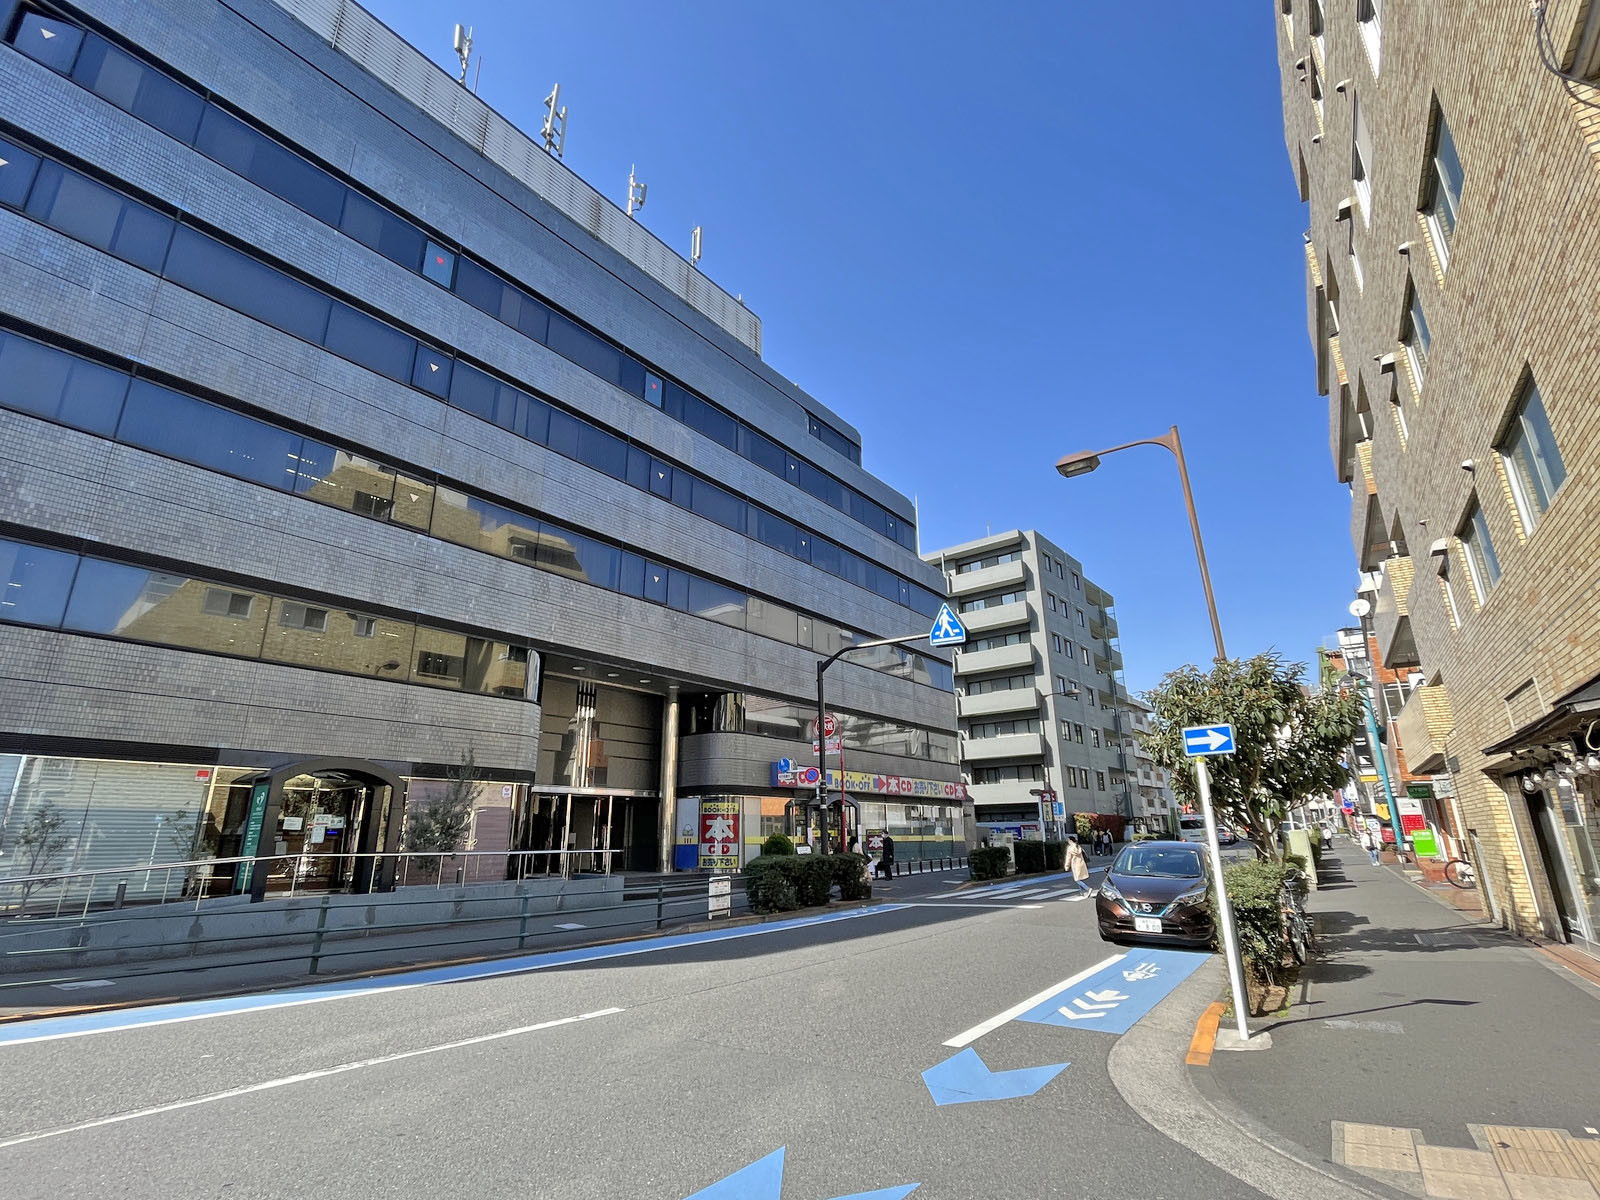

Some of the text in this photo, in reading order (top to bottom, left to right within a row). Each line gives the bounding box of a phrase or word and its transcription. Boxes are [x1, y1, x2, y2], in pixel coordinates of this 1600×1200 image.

[888, 777, 899, 793] 本
[901, 780, 912, 792] CD
[944, 784, 955, 796] CD
[705, 815, 735, 842] 本
[868, 836, 884, 849] 本
